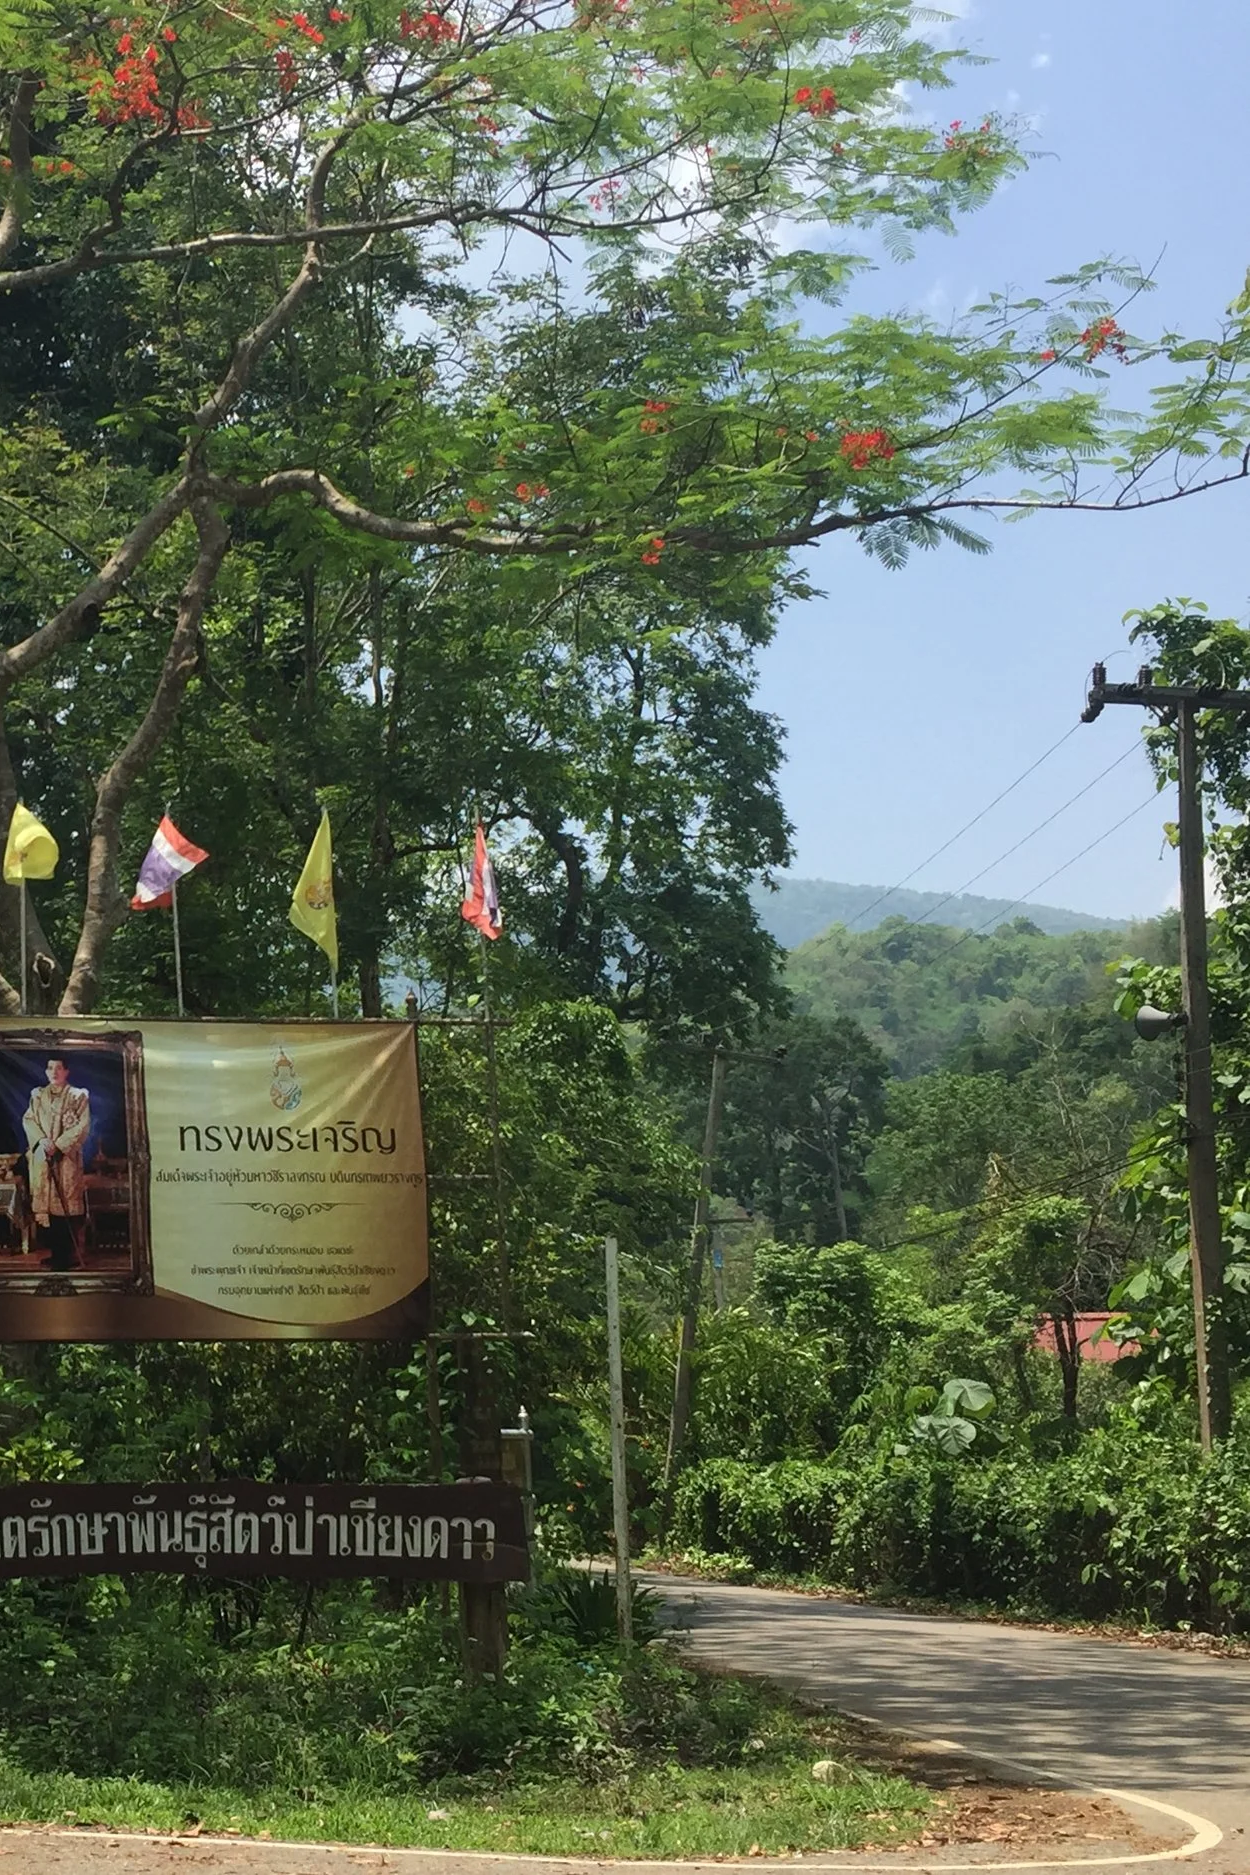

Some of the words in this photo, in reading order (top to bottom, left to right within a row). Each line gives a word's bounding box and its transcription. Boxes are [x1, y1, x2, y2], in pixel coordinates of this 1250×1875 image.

[179, 1120, 396, 1155] ทรงพระเจริญ
